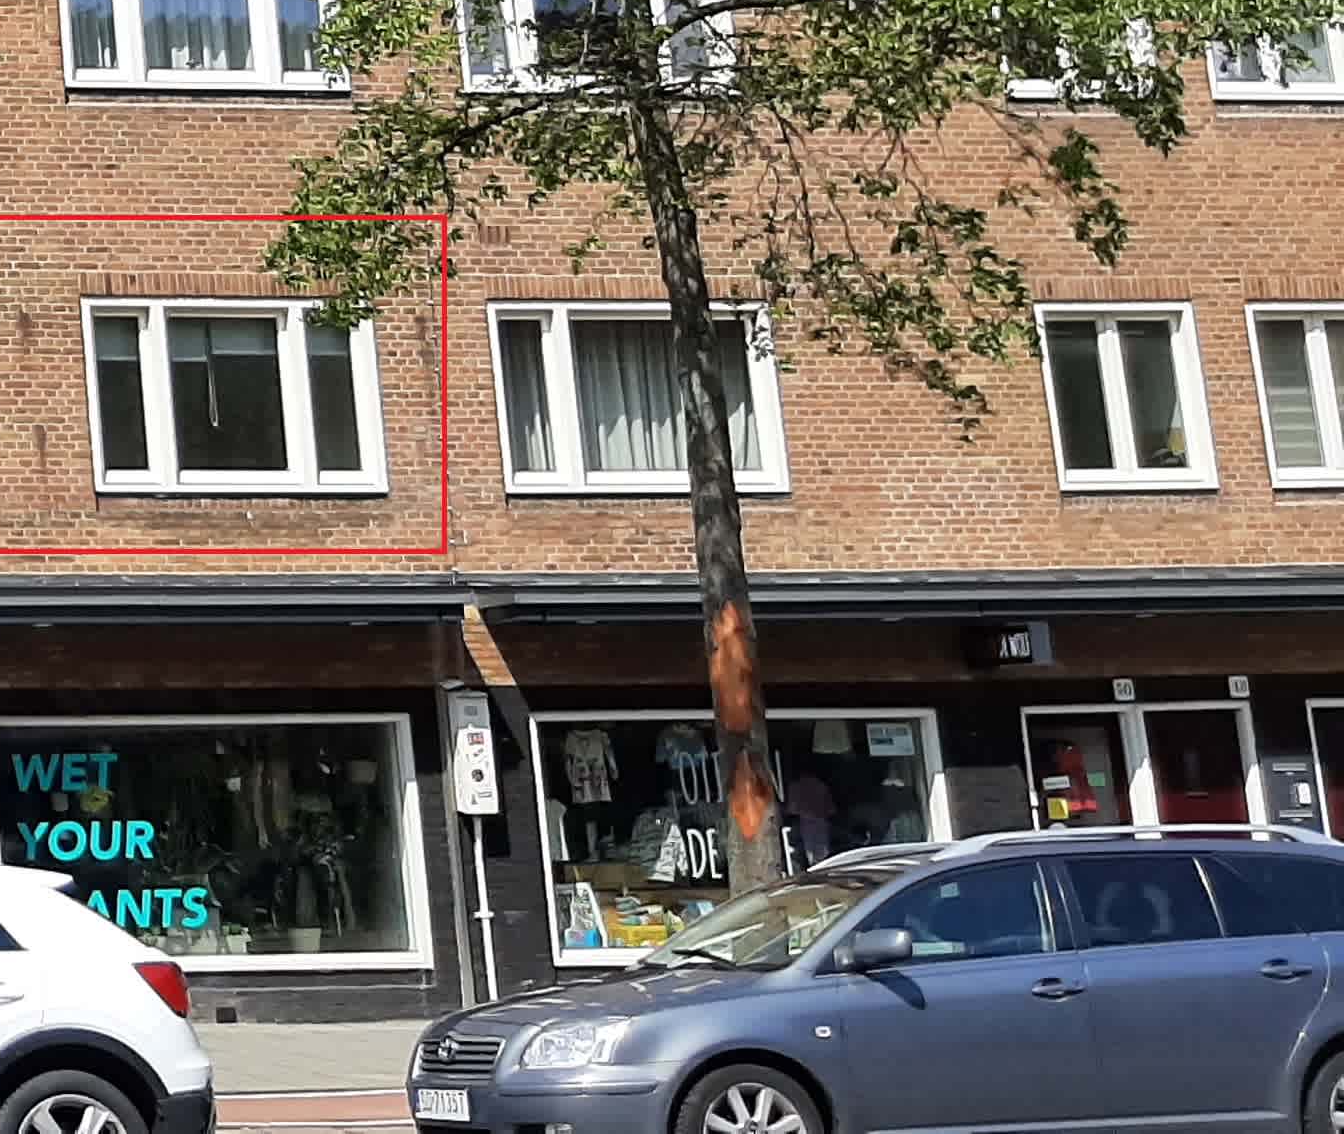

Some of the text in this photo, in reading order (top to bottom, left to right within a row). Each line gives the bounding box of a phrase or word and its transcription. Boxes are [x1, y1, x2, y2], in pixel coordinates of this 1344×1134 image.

[13, 753, 118, 792] WET
[17, 820, 155, 861] YOUR
[86, 886, 209, 929] ANTS
